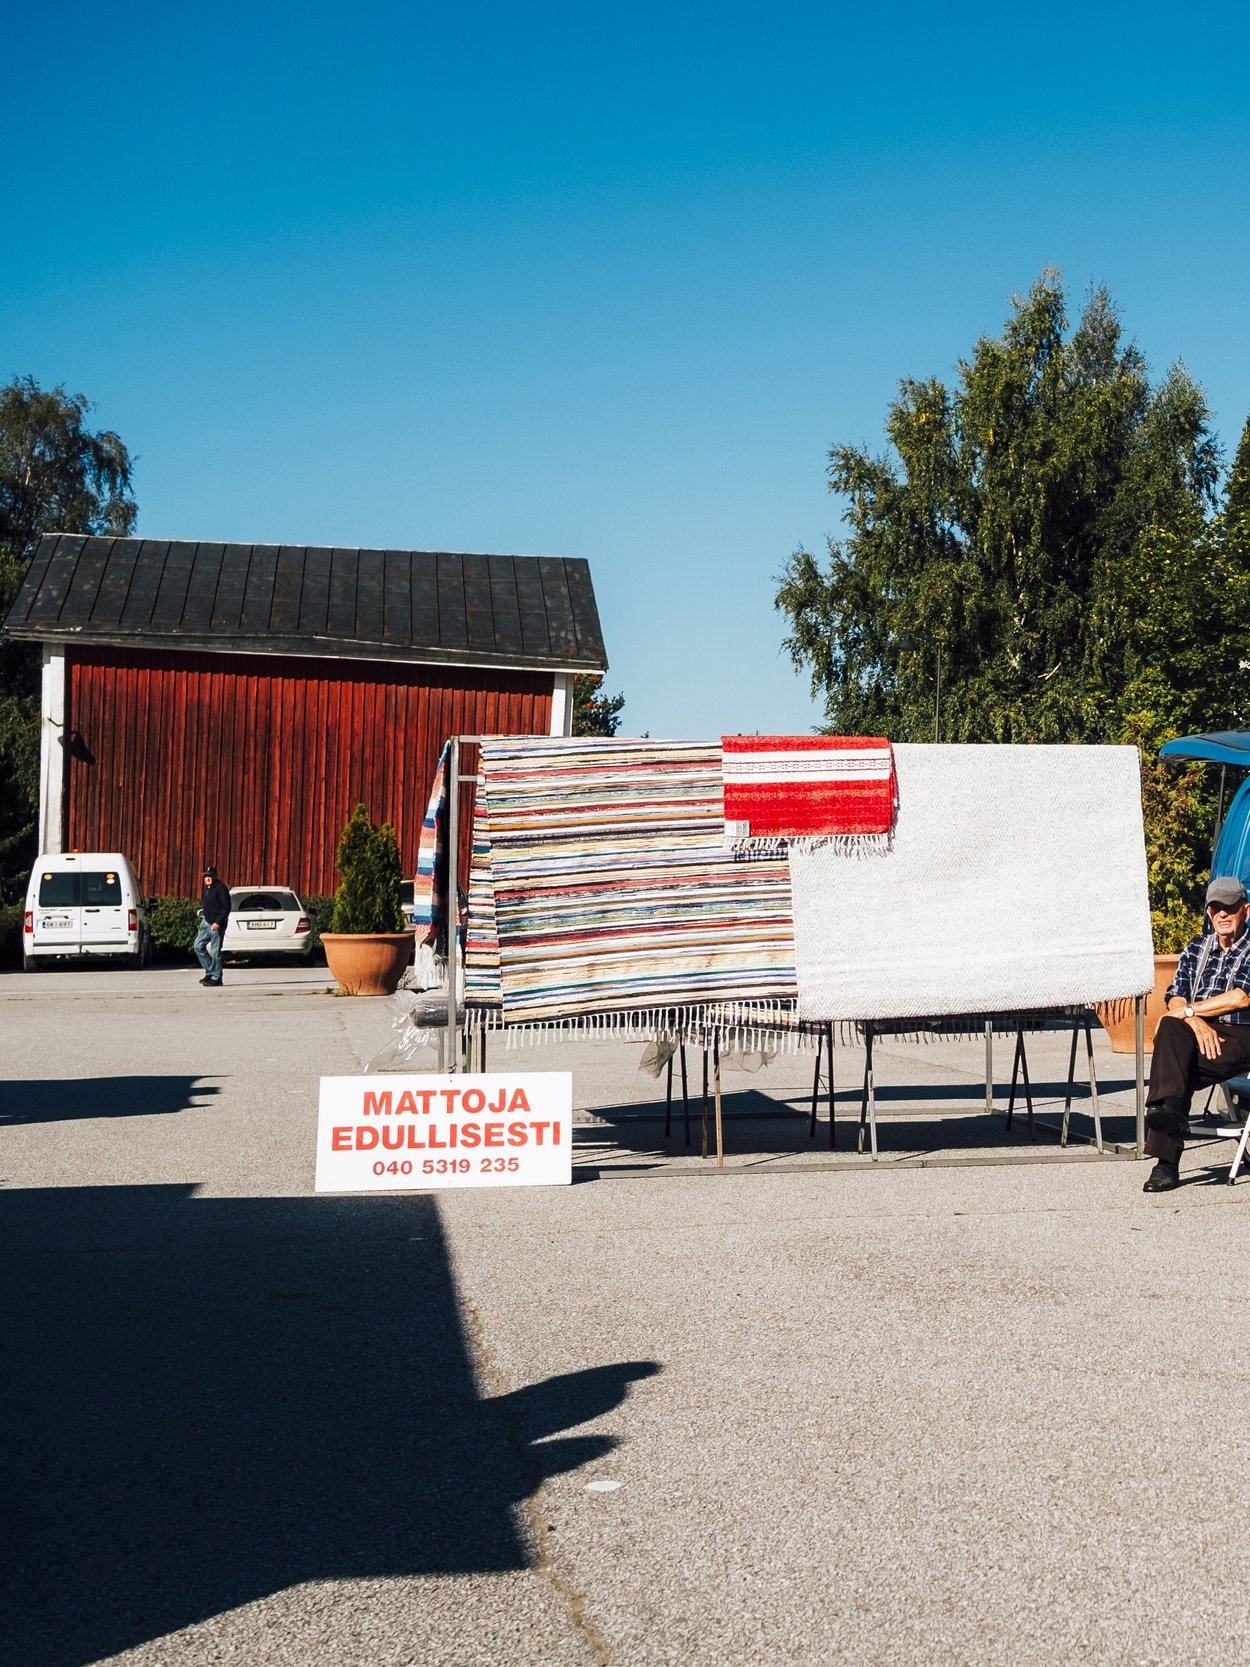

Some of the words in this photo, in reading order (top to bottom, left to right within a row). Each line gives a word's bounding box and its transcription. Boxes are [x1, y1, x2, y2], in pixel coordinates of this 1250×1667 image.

[363, 1088, 531, 1116] MATTOJA
[332, 1122, 560, 1151] EDULLISESTI
[373, 1160, 413, 1176] 040
[422, 1159, 470, 1174] 5319
[481, 1158, 519, 1172] 235
